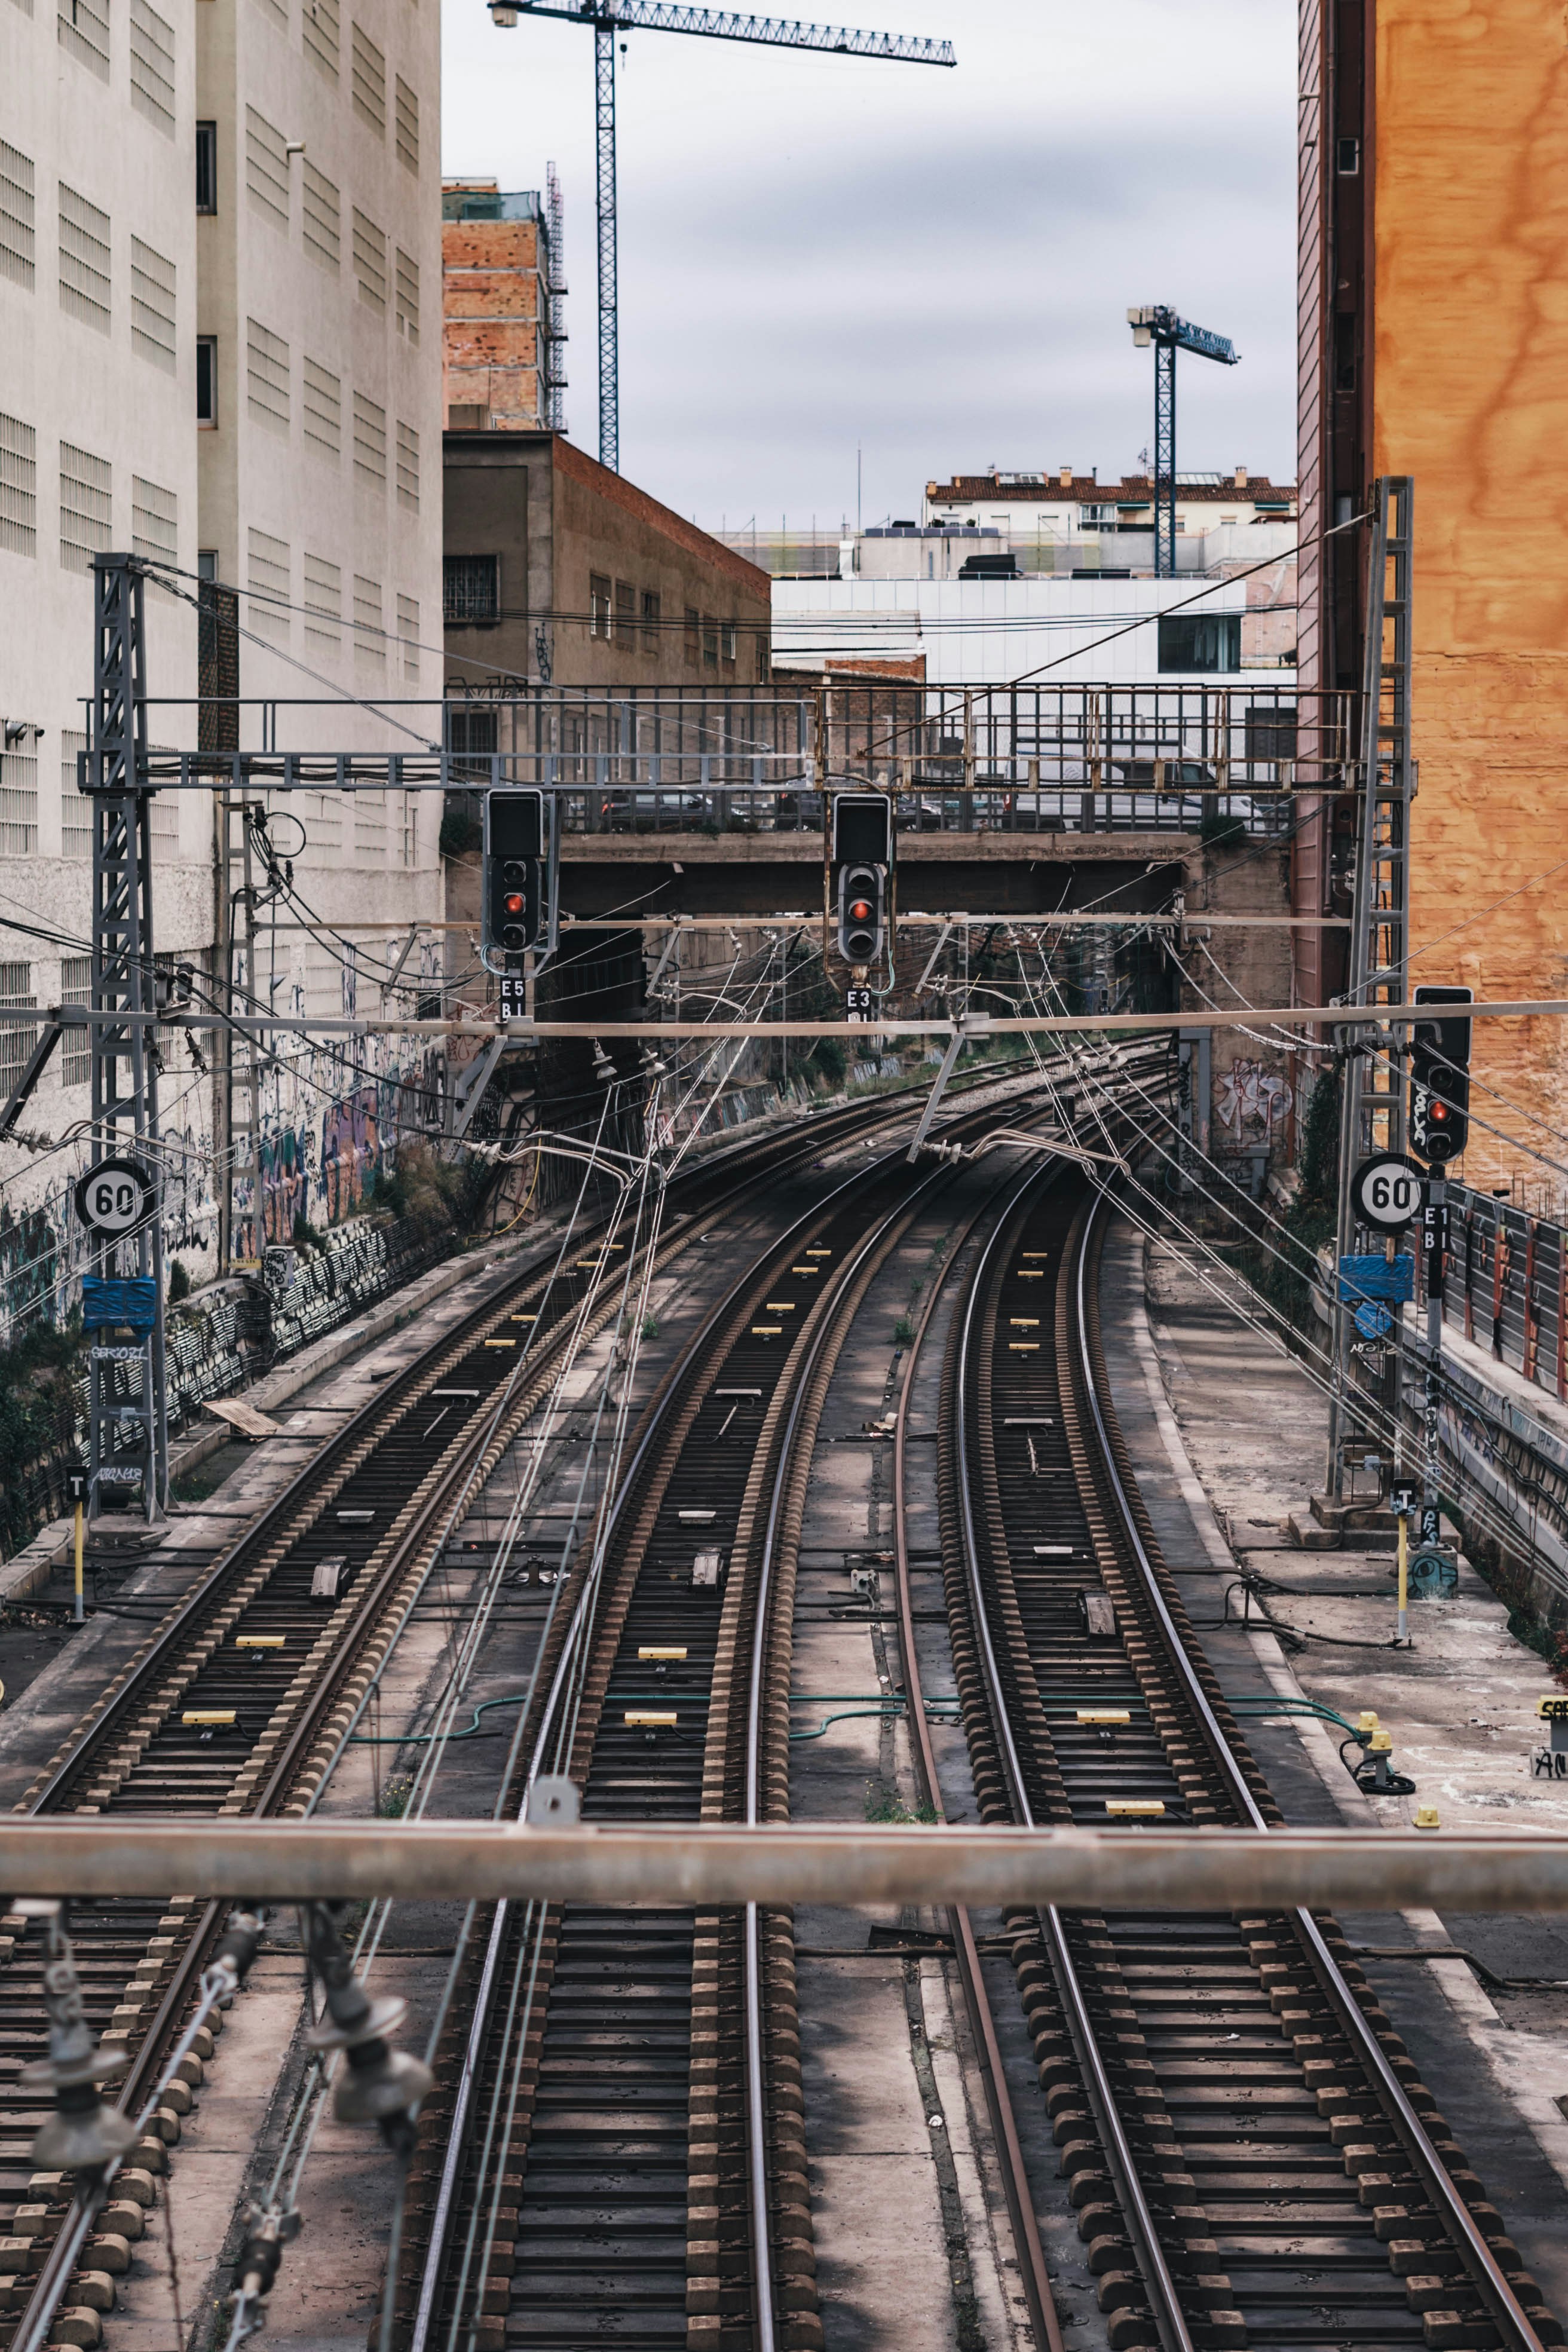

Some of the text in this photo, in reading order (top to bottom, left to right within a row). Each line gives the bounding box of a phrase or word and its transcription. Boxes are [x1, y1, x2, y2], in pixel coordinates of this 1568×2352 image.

[96, 1184, 134, 1216] 60
[1372, 1177, 1410, 1209] 60
[70, 1477, 84, 1496] T
[1398, 1490, 1412, 1509] T
